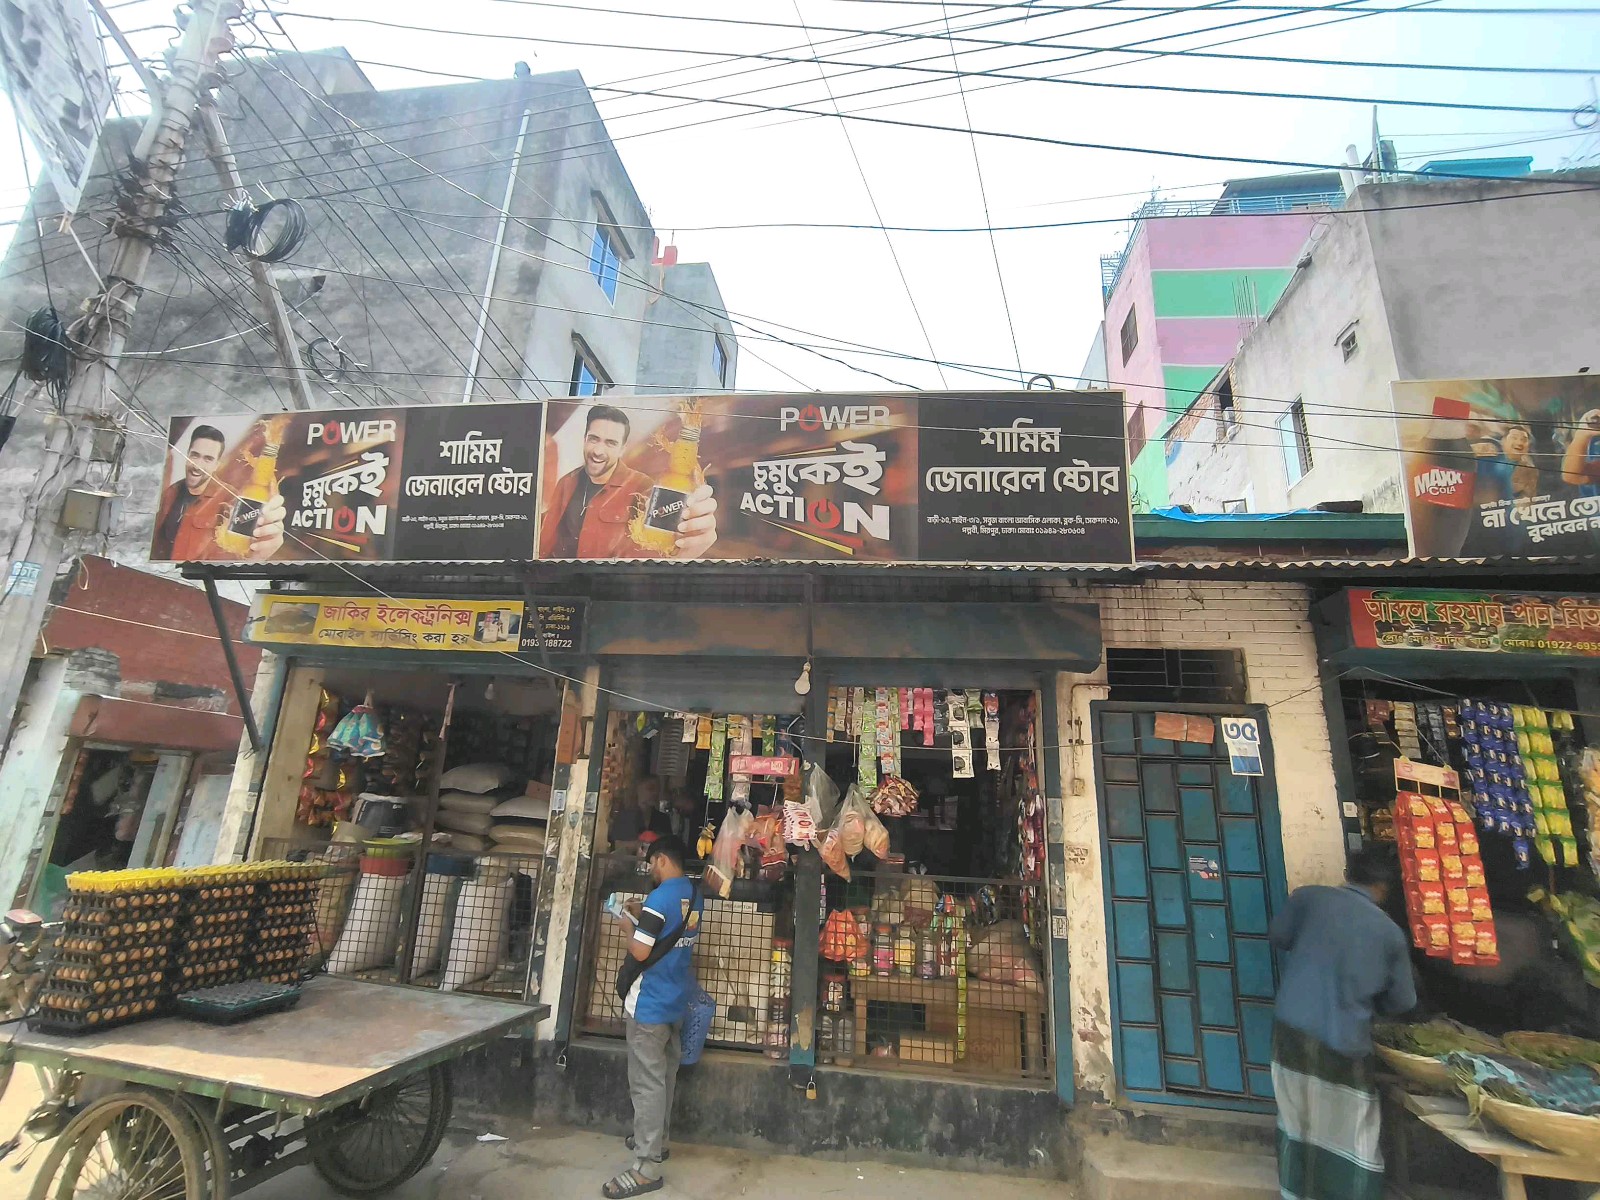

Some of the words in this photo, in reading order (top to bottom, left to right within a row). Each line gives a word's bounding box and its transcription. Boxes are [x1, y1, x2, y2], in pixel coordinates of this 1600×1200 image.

[306, 419, 397, 445] POWER
[780, 405, 890, 431] POWER
[439, 431, 502, 464] শামিম
[979, 418, 1062, 453] শামিম
[301, 452, 390, 507] চুমুকেই
[405, 474, 485, 497] জেনারেল
[488, 467, 533, 496] ষ্টোর
[752, 441, 886, 496] চুমুকেই
[925, 466, 1046, 495] জেনারেল
[1054, 459, 1120, 495] ষ্টোর
[1414, 469, 1463, 498] MAXX
[1428, 485, 1456, 496] COLA
[291, 505, 388, 535] ACTION
[652, 500, 683, 518] POWER
[740, 492, 890, 540] ACTION
[1481, 509, 1506, 528] না
[1527, 518, 1587, 543] বুঝবেন
[324, 602, 371, 621] জাকির
[1512, 601, 1554, 629] পান
[423, 633, 446, 643] করা
[522, 639, 572, 647] 0193188722
